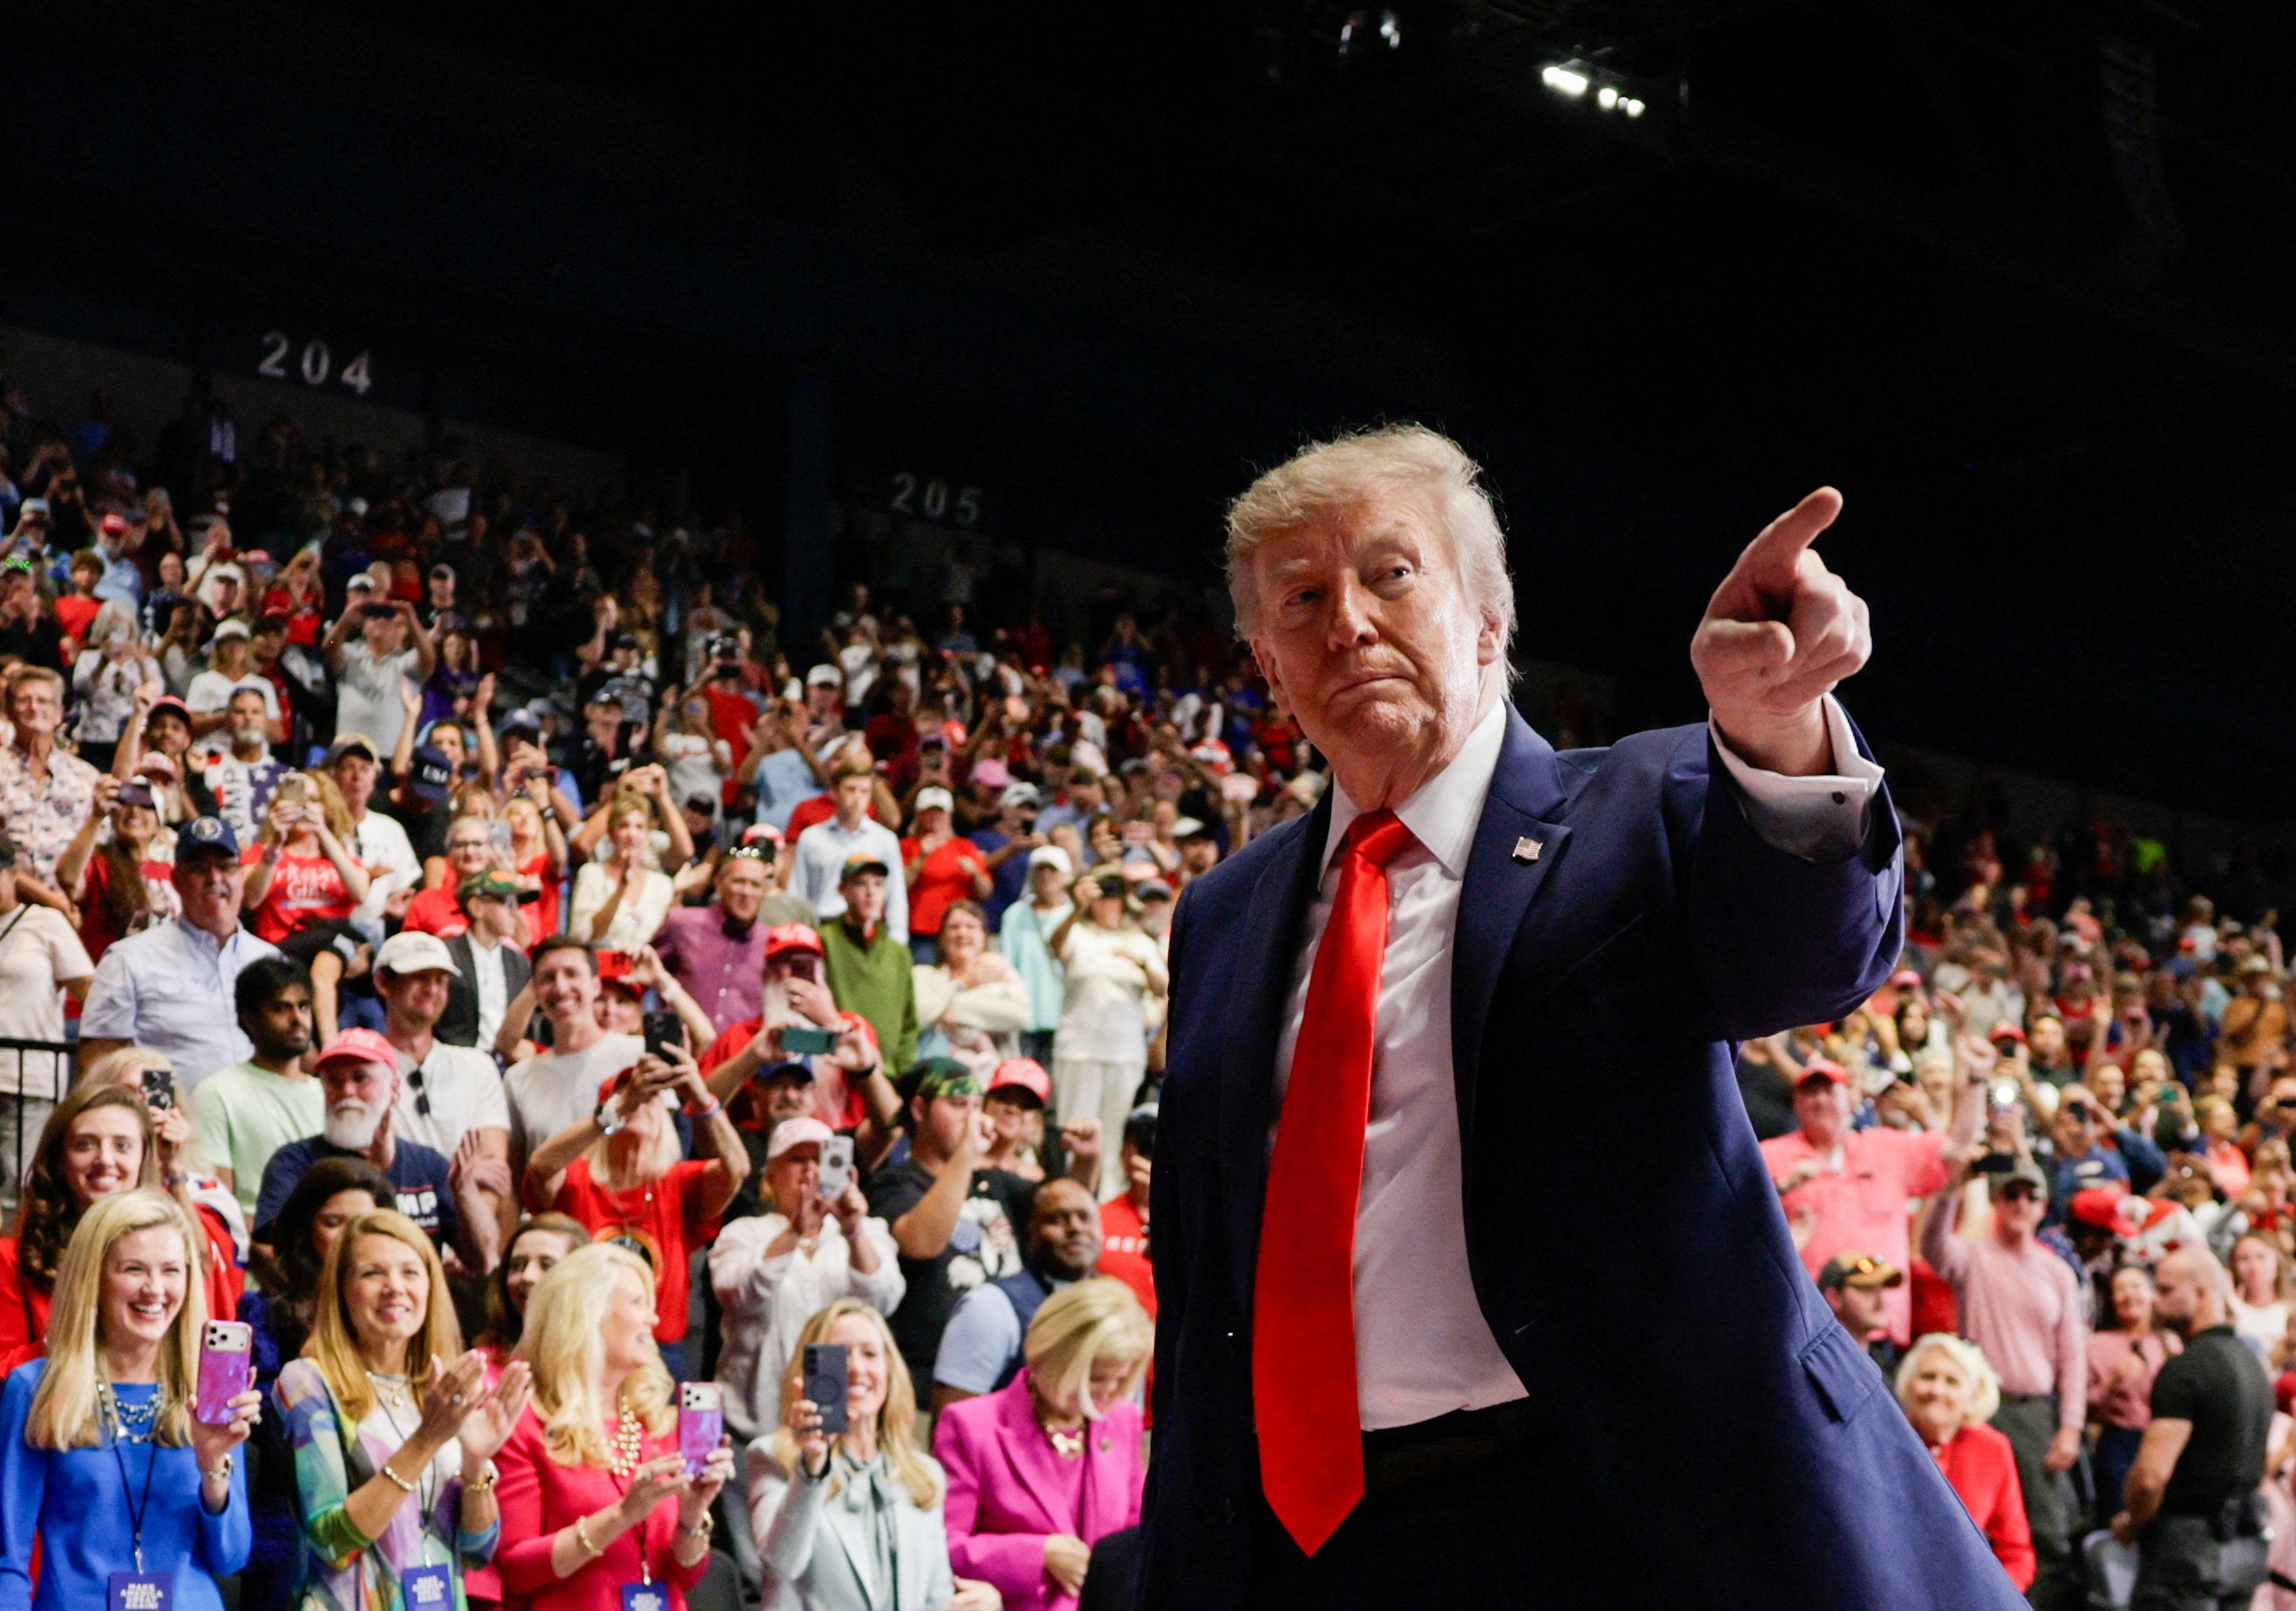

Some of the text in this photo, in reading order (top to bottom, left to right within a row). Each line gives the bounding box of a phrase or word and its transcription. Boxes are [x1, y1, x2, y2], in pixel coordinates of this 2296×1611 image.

[259, 331, 371, 395] 204
[890, 472, 982, 525] 205
[395, 1191, 438, 1216] MP
